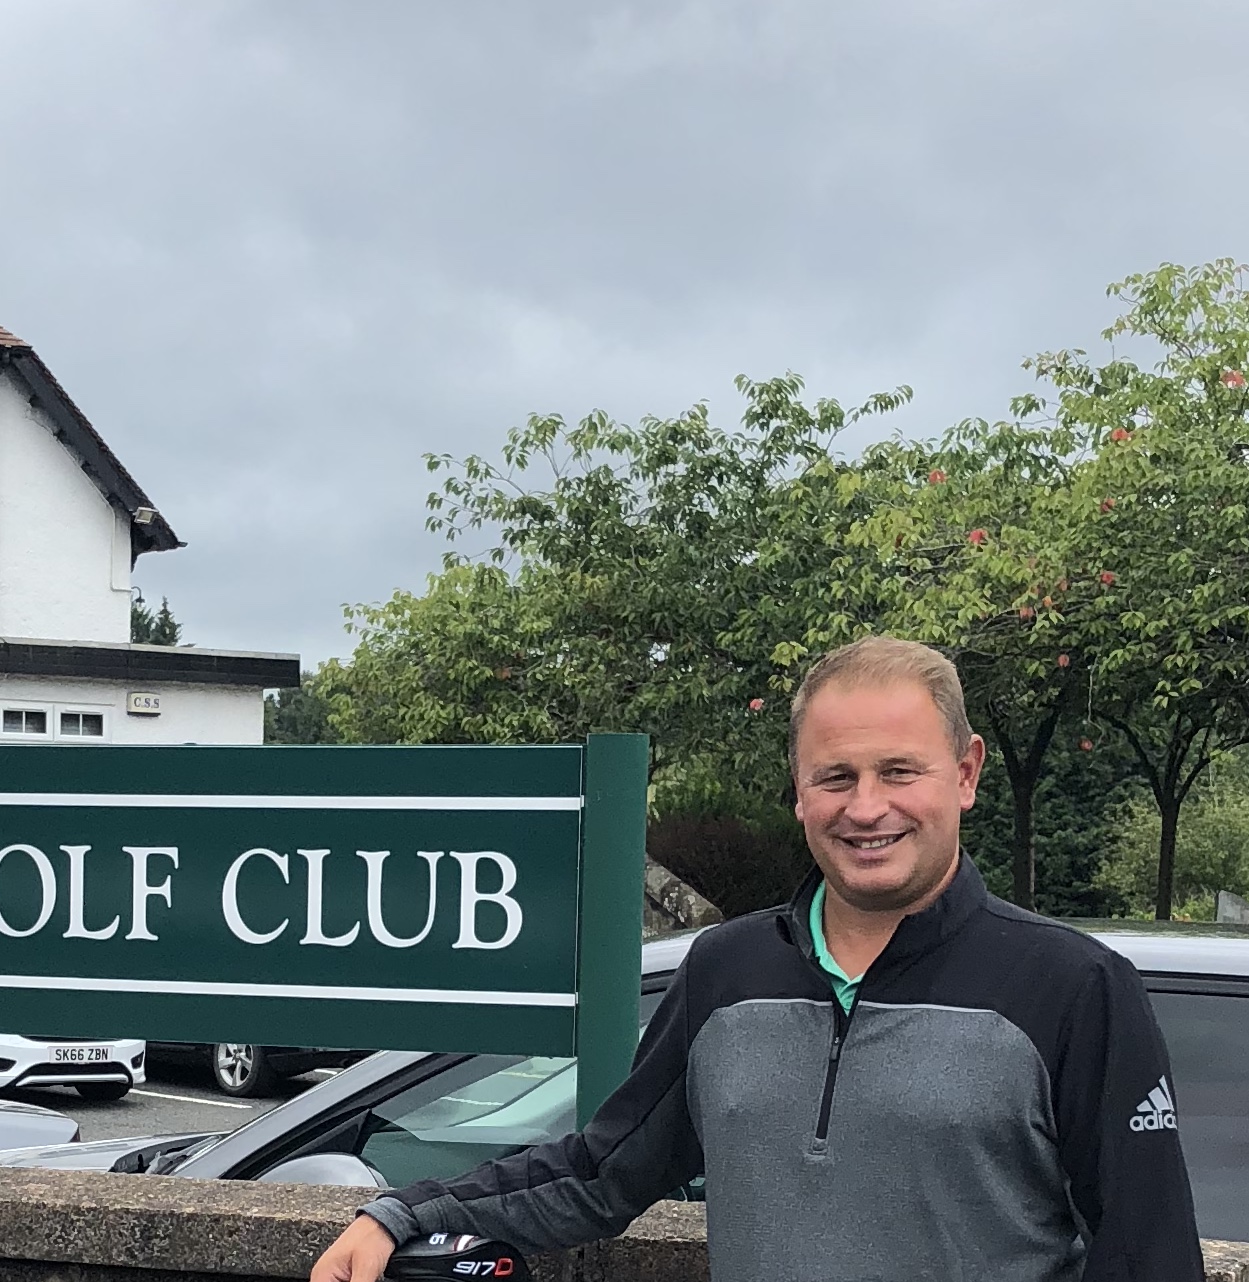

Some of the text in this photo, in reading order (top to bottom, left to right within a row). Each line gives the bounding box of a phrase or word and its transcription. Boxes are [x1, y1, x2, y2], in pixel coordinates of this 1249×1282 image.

[221, 847, 523, 950] CLUB
[55, 1048, 109, 1061] SK66 ZBN
[452, 1257, 514, 1276] 917D
